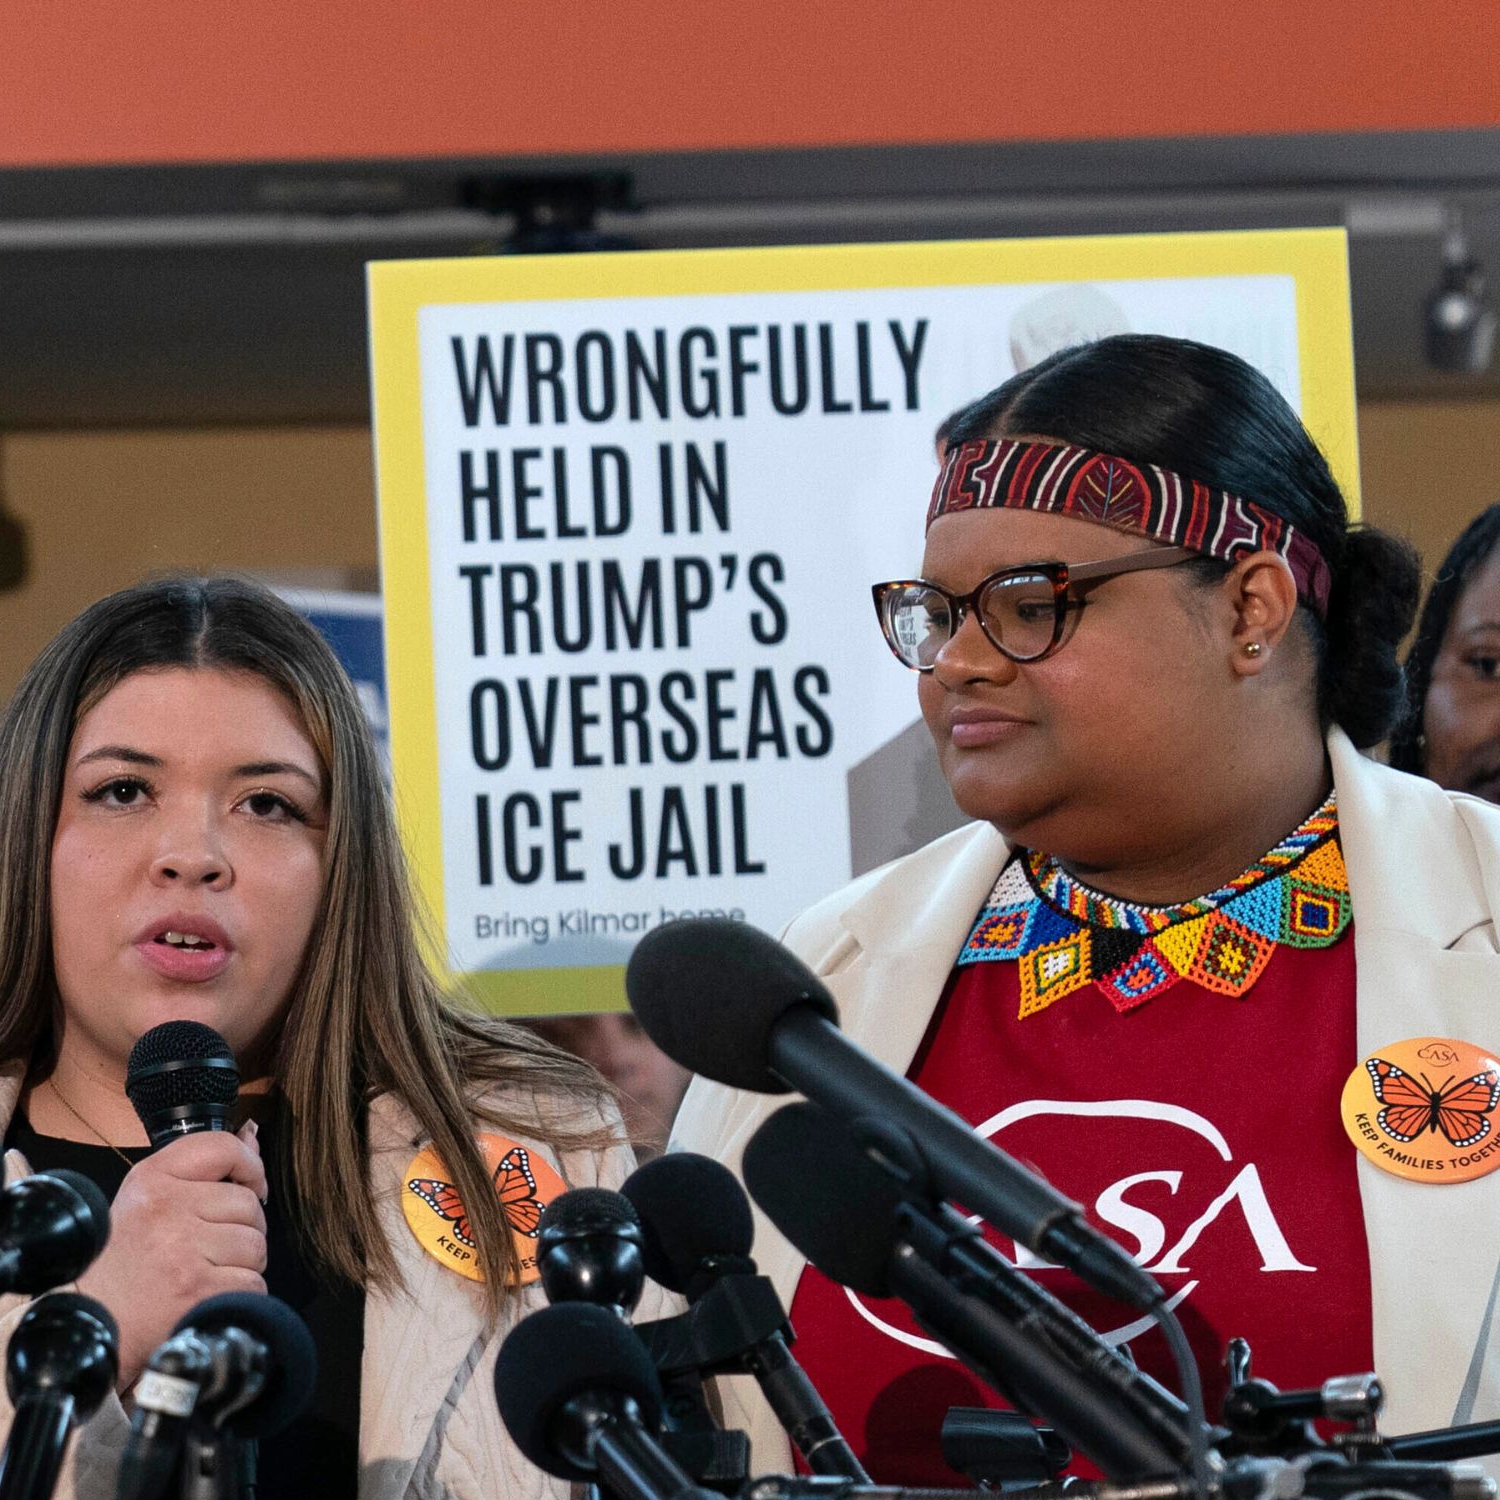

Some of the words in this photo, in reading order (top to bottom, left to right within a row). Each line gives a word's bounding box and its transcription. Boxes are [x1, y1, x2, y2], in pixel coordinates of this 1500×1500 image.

[449, 318, 930, 427] WRONGFULLY
[458, 443, 633, 544] HELD
[660, 440, 731, 534] IN
[459, 552, 789, 659] TRUMP'S
[468, 666, 833, 771] OVERSEAS
[474, 790, 583, 887] ICE
[609, 783, 766, 882] JAIL
[475, 912, 549, 945] Bring
[559, 908, 650, 936] Kilmar
[1355, 1113, 1379, 1142] KEEP
[1376, 1142, 1444, 1170] FAMILIES
[1449, 1133, 1500, 1168] TOGETH
[437, 1235, 471, 1261] KEEP
